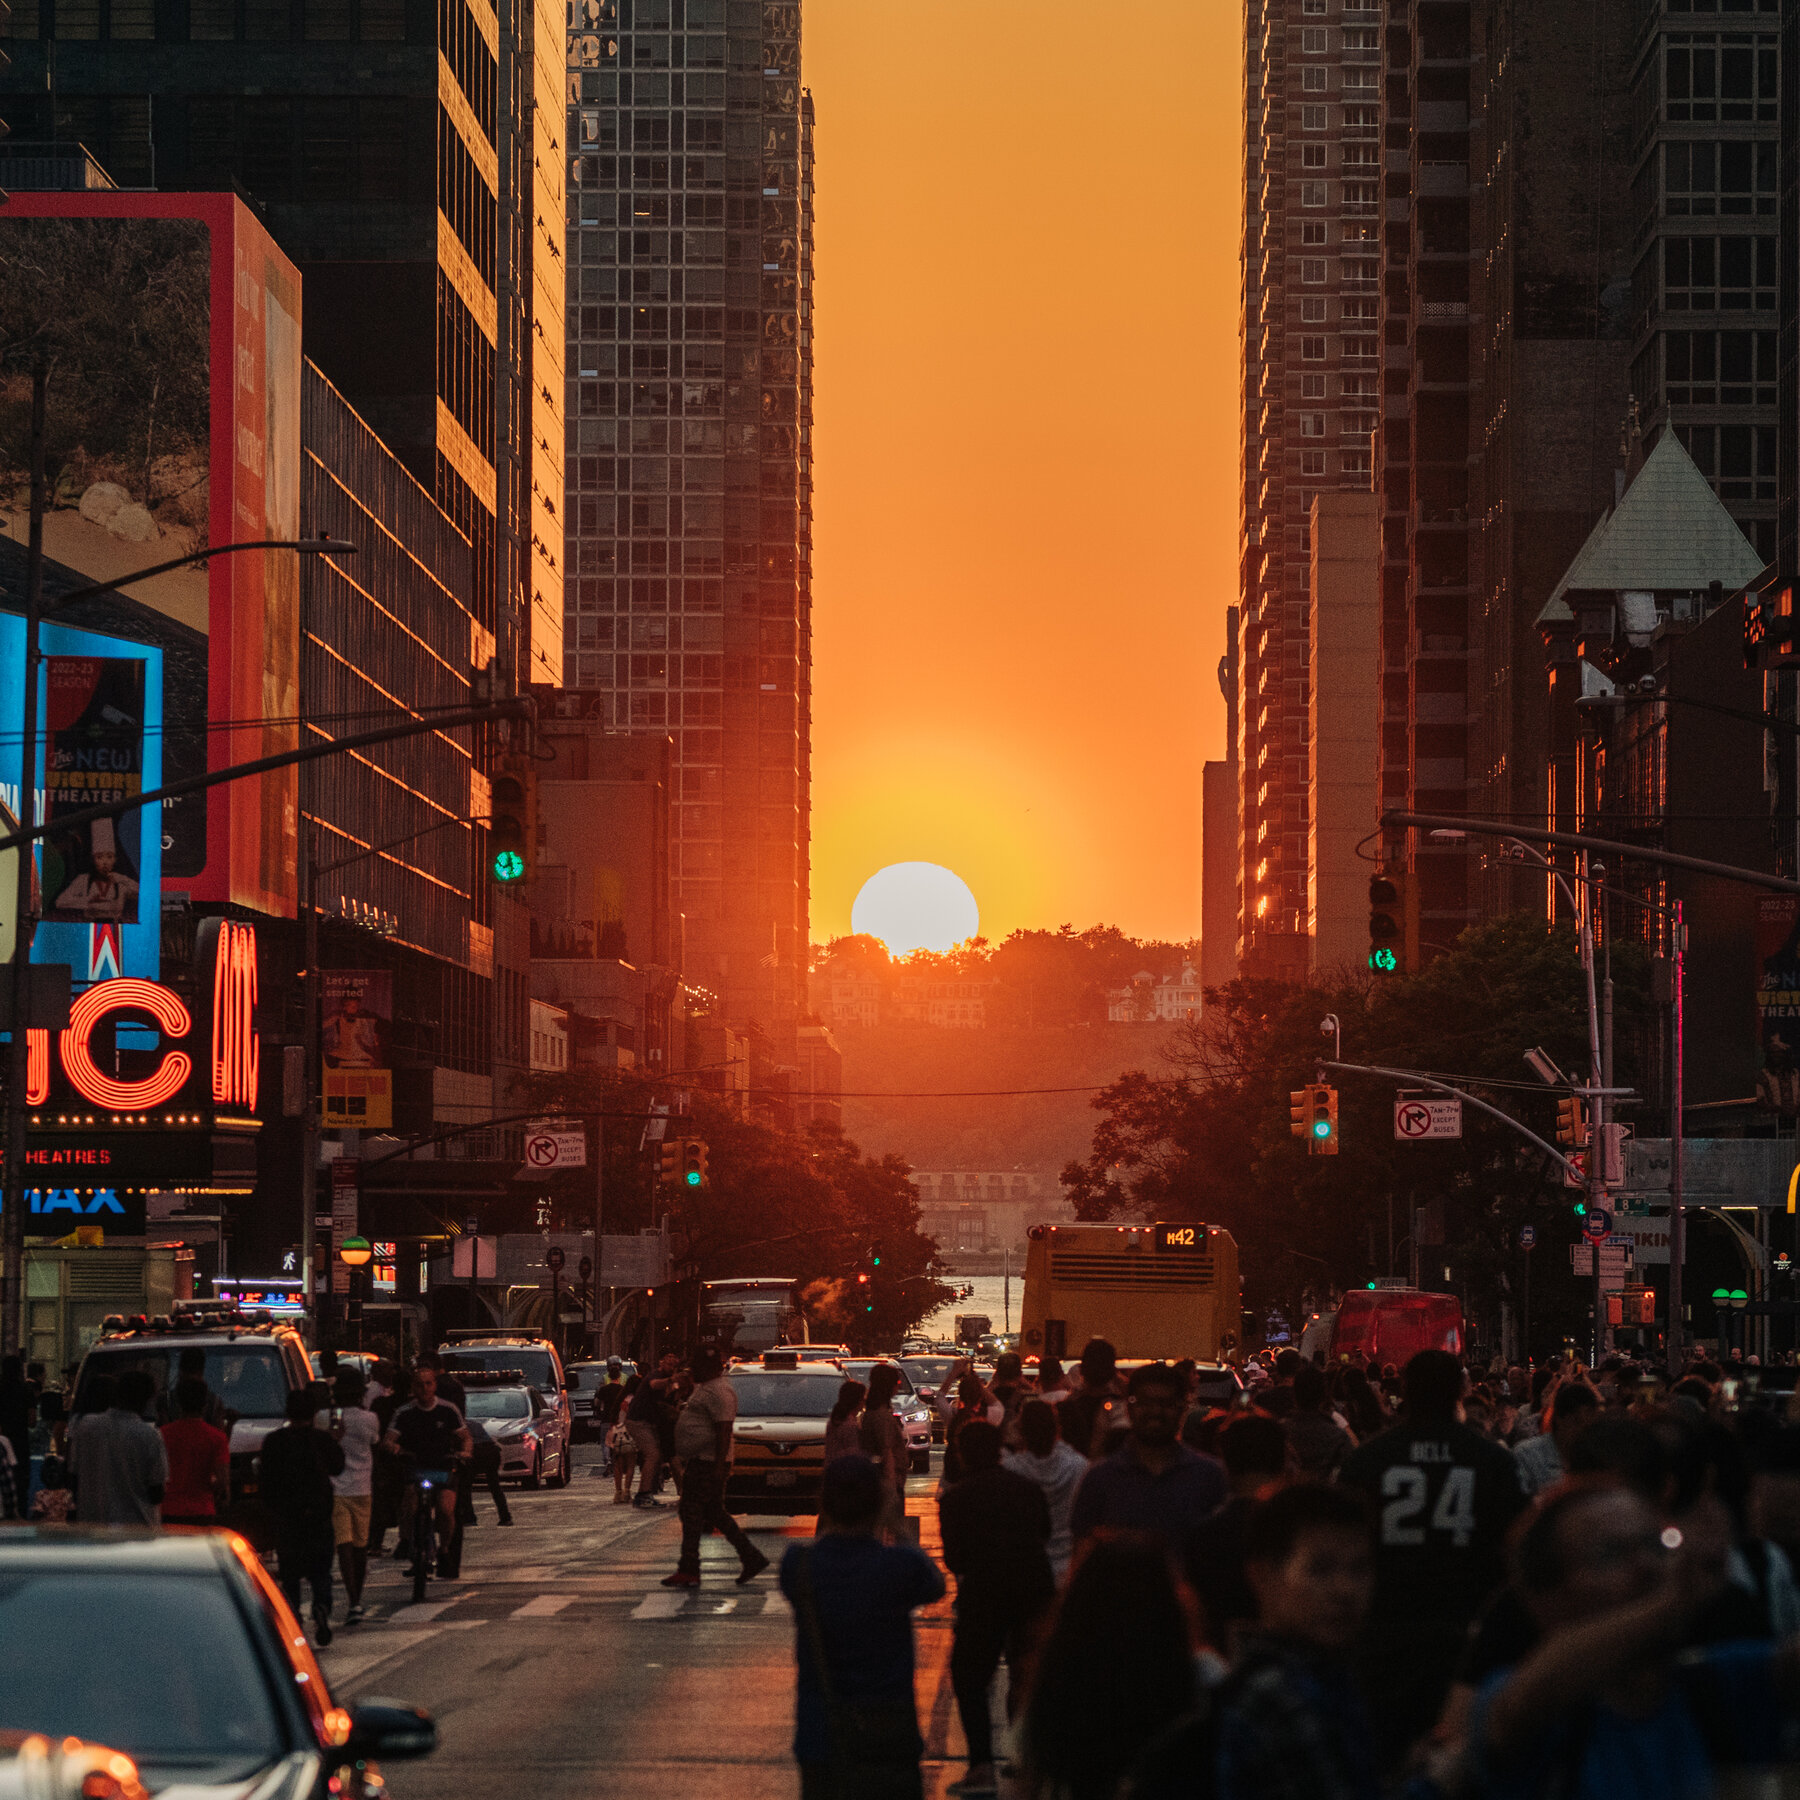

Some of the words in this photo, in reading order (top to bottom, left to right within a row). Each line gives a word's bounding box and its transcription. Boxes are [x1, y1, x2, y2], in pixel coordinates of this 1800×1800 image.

[52, 677, 92, 688] SEASON
[76, 748, 131, 770] NEW
[49, 789, 124, 803] THEATER
[1760, 900, 1796, 910] 2022-23
[1760, 911, 1792, 921] SEASON
[326, 988, 364, 997] started
[1430, 1106, 1459, 1114] 7AM-7PM
[560, 1146, 582, 1154] EXCEPT
[26, 1150, 111, 1165] HEATRES
[1622, 1200, 1629, 1210] 8
[1166, 1228, 1195, 1246] M42
[1409, 1440, 1454, 1463] BELL
[1381, 1465, 1476, 1547] 24
